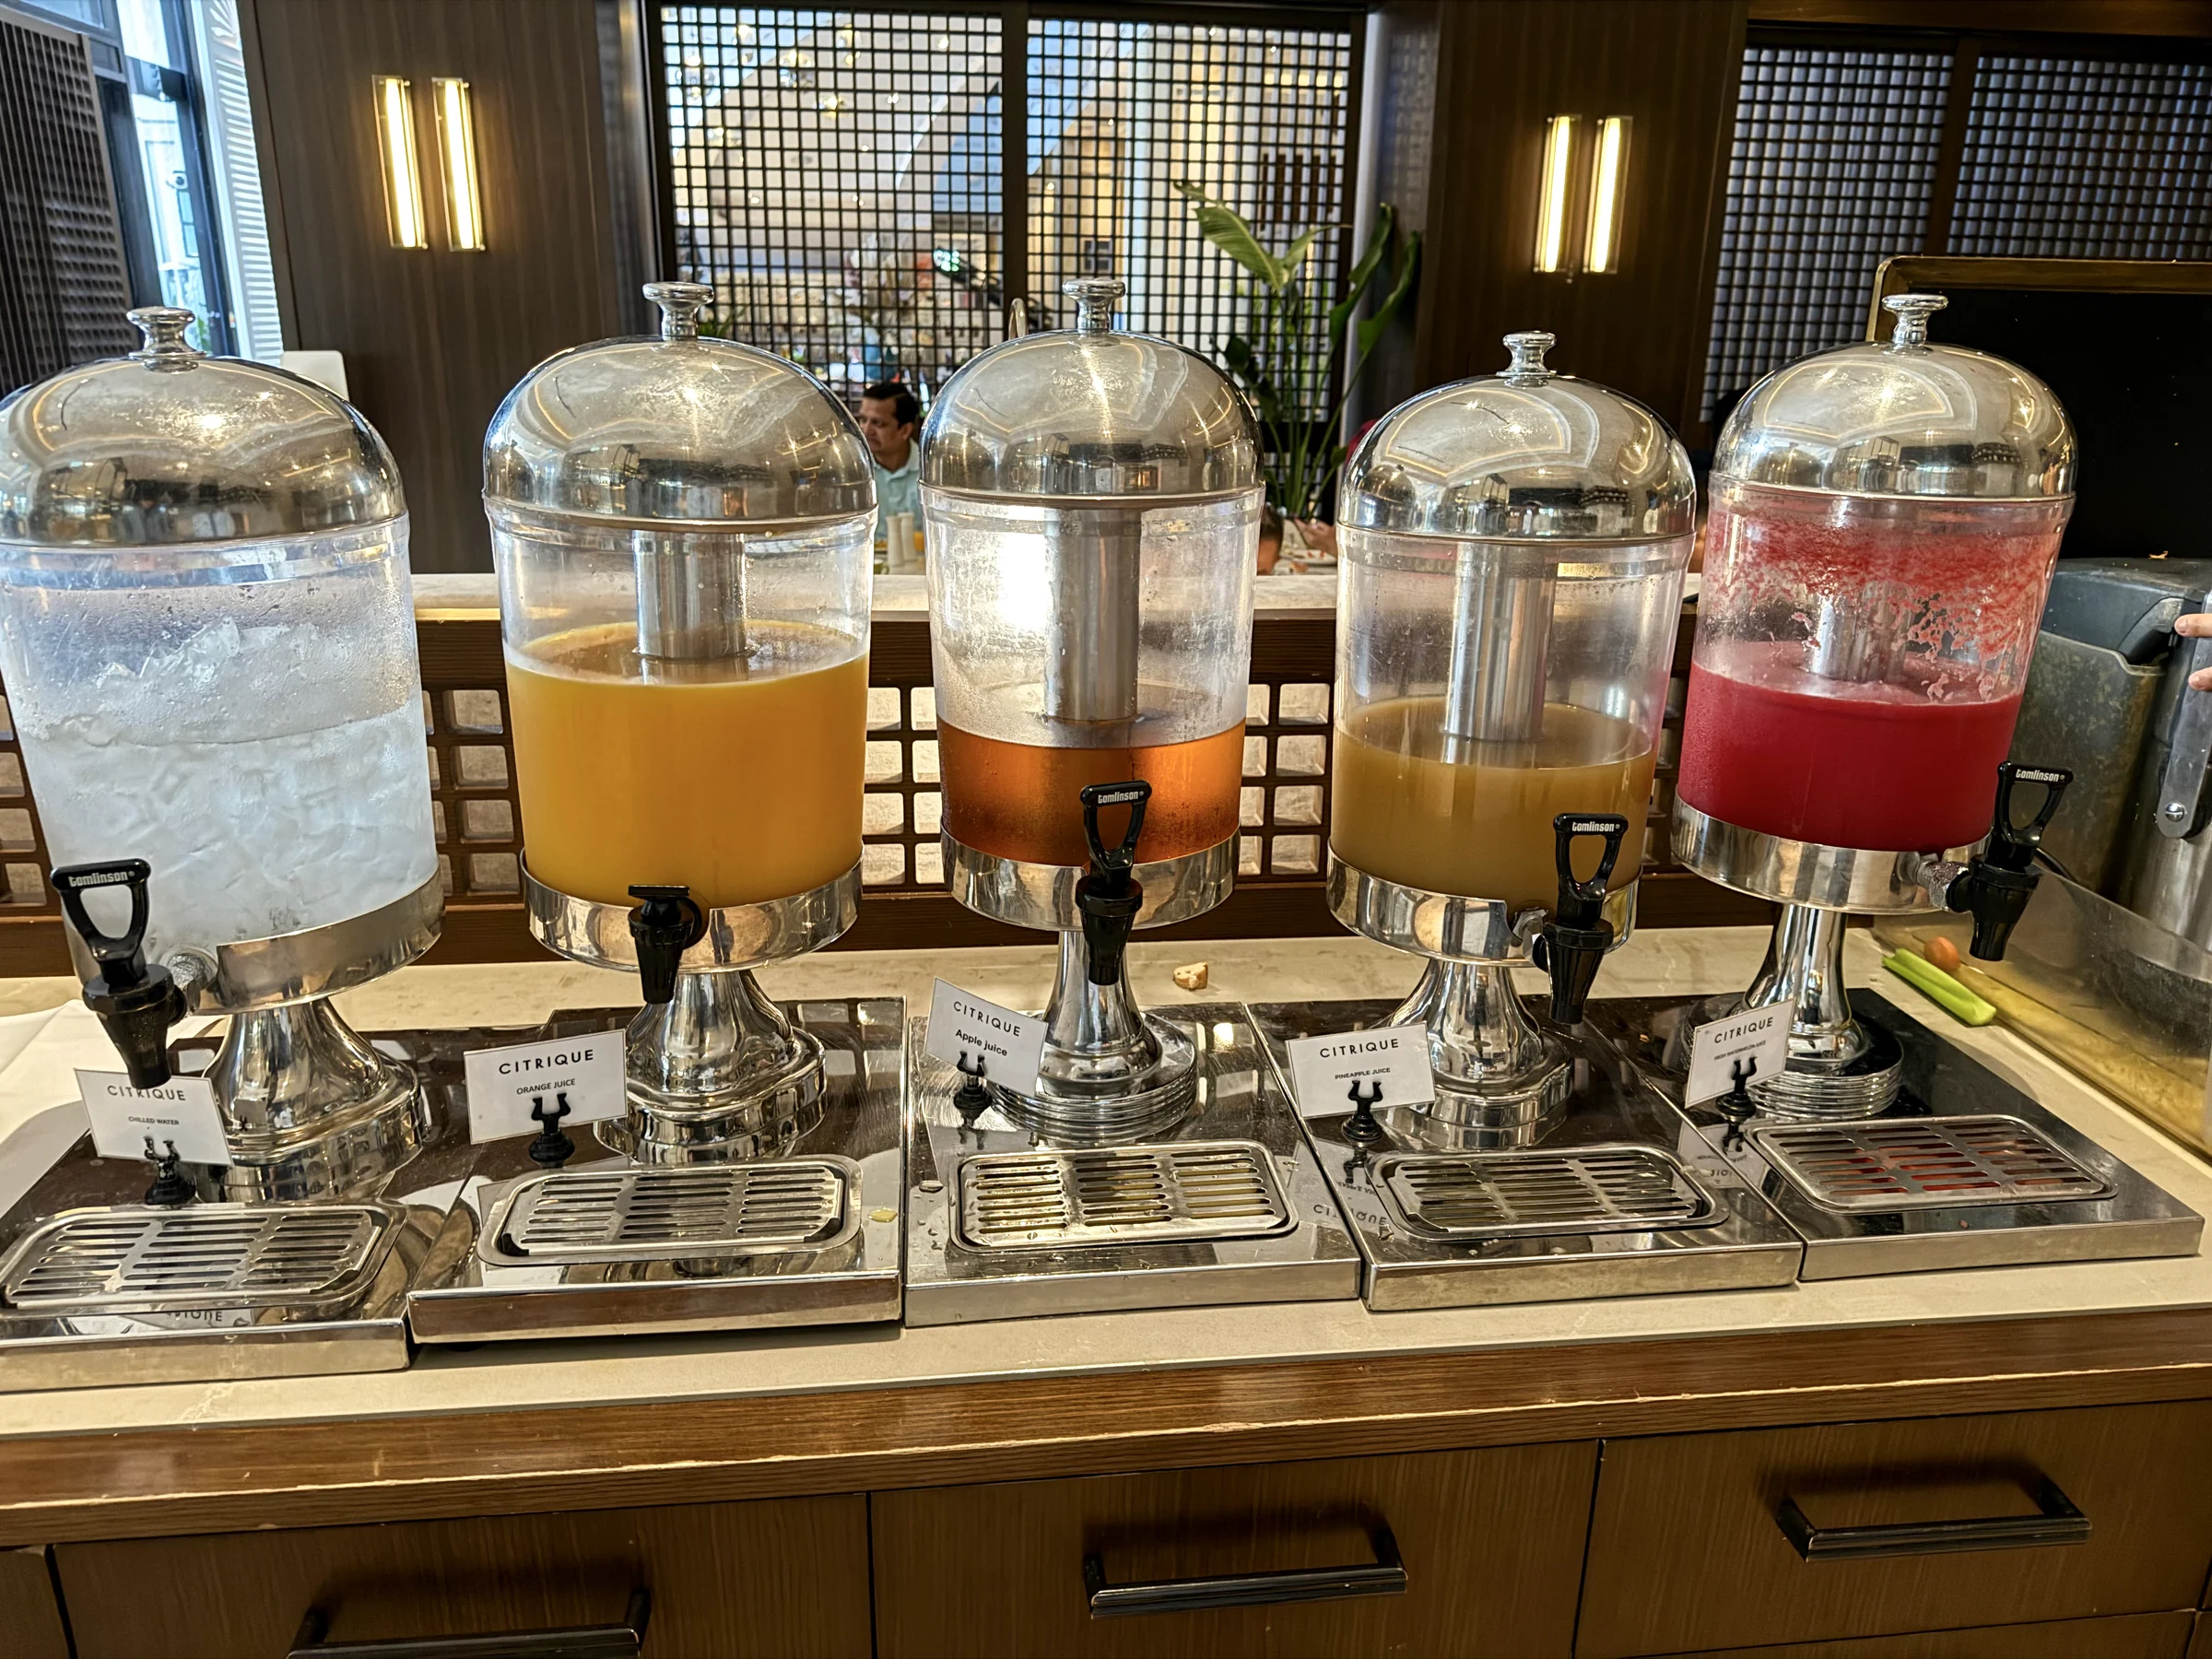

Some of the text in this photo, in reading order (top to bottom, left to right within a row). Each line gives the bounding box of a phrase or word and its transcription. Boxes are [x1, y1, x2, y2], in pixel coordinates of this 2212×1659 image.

[953, 1001, 1021, 1037] CITRIQUE
[1714, 1017, 1773, 1044] CITRIQUE
[955, 1029, 1008, 1057] Apple juice
[1319, 1038, 1399, 1058] CITRIQUE
[499, 1049, 594, 1075] CITRIQUE
[1335, 1066, 1391, 1080] PINEAPPLE JUICE
[516, 1077, 576, 1095] ORANGE JUICE
[128, 1115, 156, 1124] CHILLED
